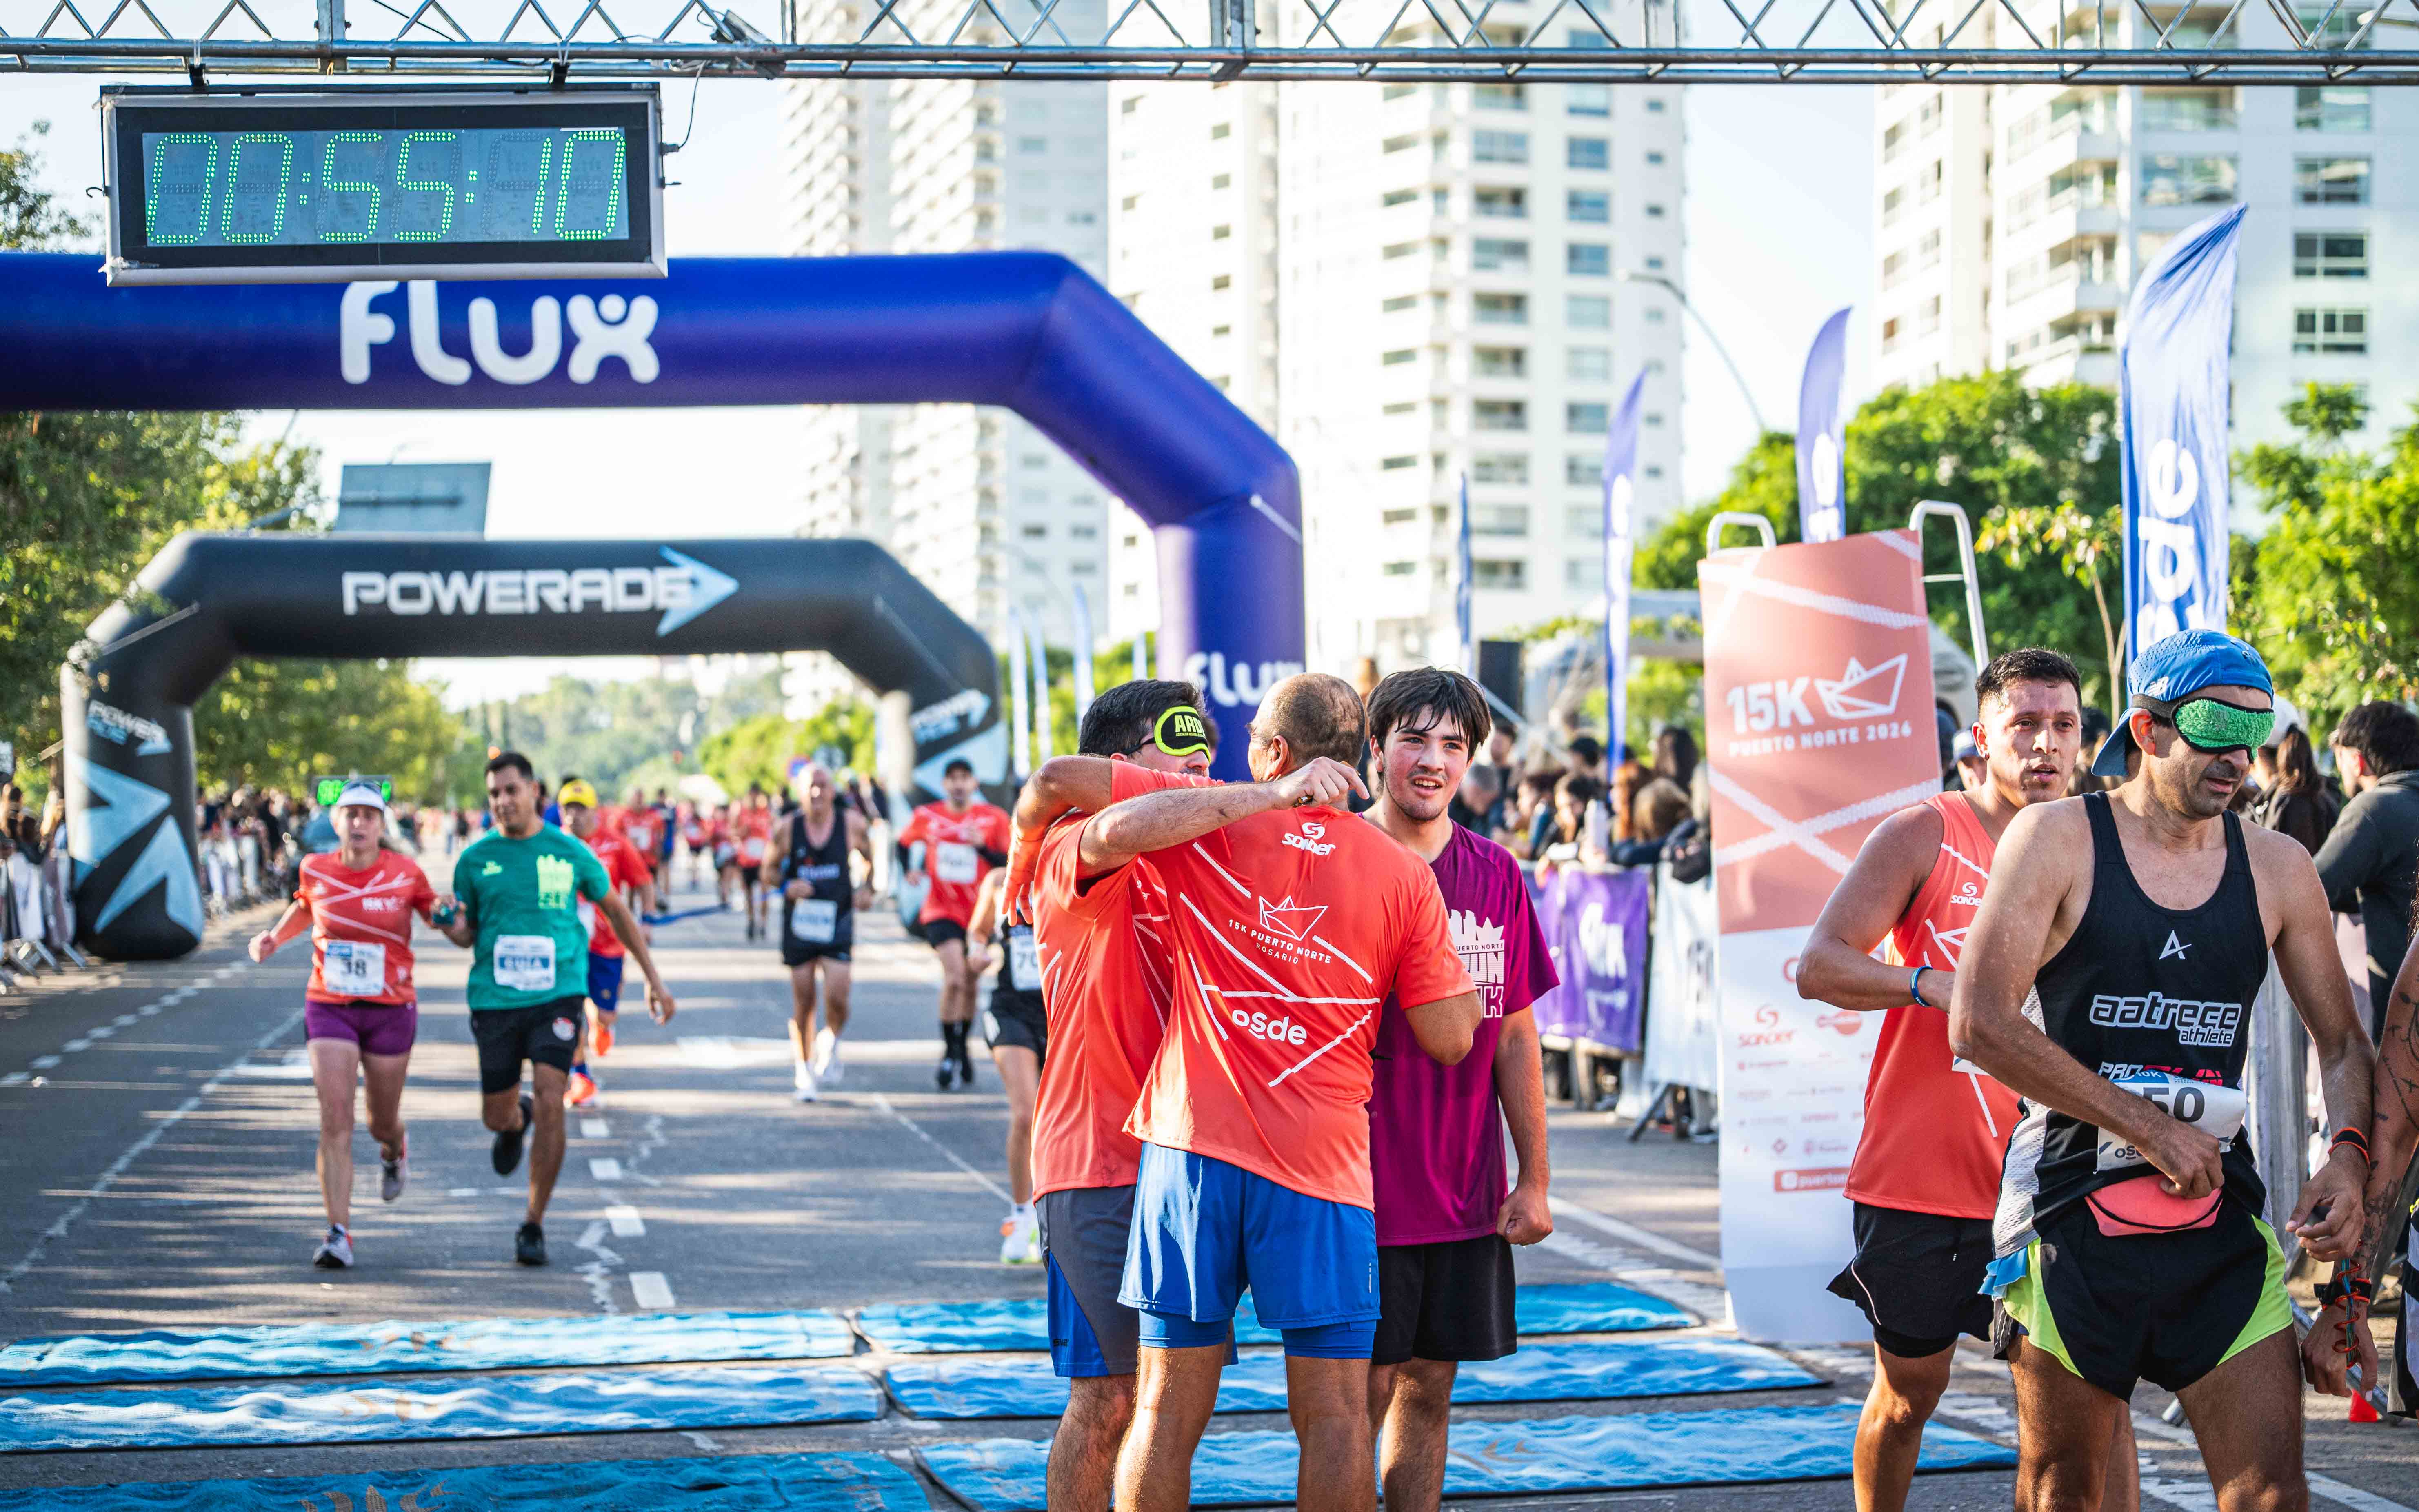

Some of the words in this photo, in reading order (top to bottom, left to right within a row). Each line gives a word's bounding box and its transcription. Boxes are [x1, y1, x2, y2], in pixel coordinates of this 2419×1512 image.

[146, 131, 626, 244] 00:55:10
[341, 280, 659, 385] flux
[342, 568, 693, 615] POWERADE
[1185, 651, 1304, 708] flu
[1175, 715, 1205, 734] ARD
[1727, 676, 1815, 735] 15K
[1728, 734, 1795, 758] PUERTO
[1800, 726, 1859, 748] NORTE
[1866, 720, 1912, 741] 2026
[1228, 919, 1247, 933] 15K
[1251, 929, 1294, 951] PUERTO
[1296, 946, 1331, 964] NORTE
[1256, 942, 1299, 964] ROSARIO
[1232, 1010, 1307, 1045] osde
[2089, 992, 2242, 1031] aatrece
[2179, 1026, 2235, 1047] athlete
[2115, 1145, 2142, 1160] os
